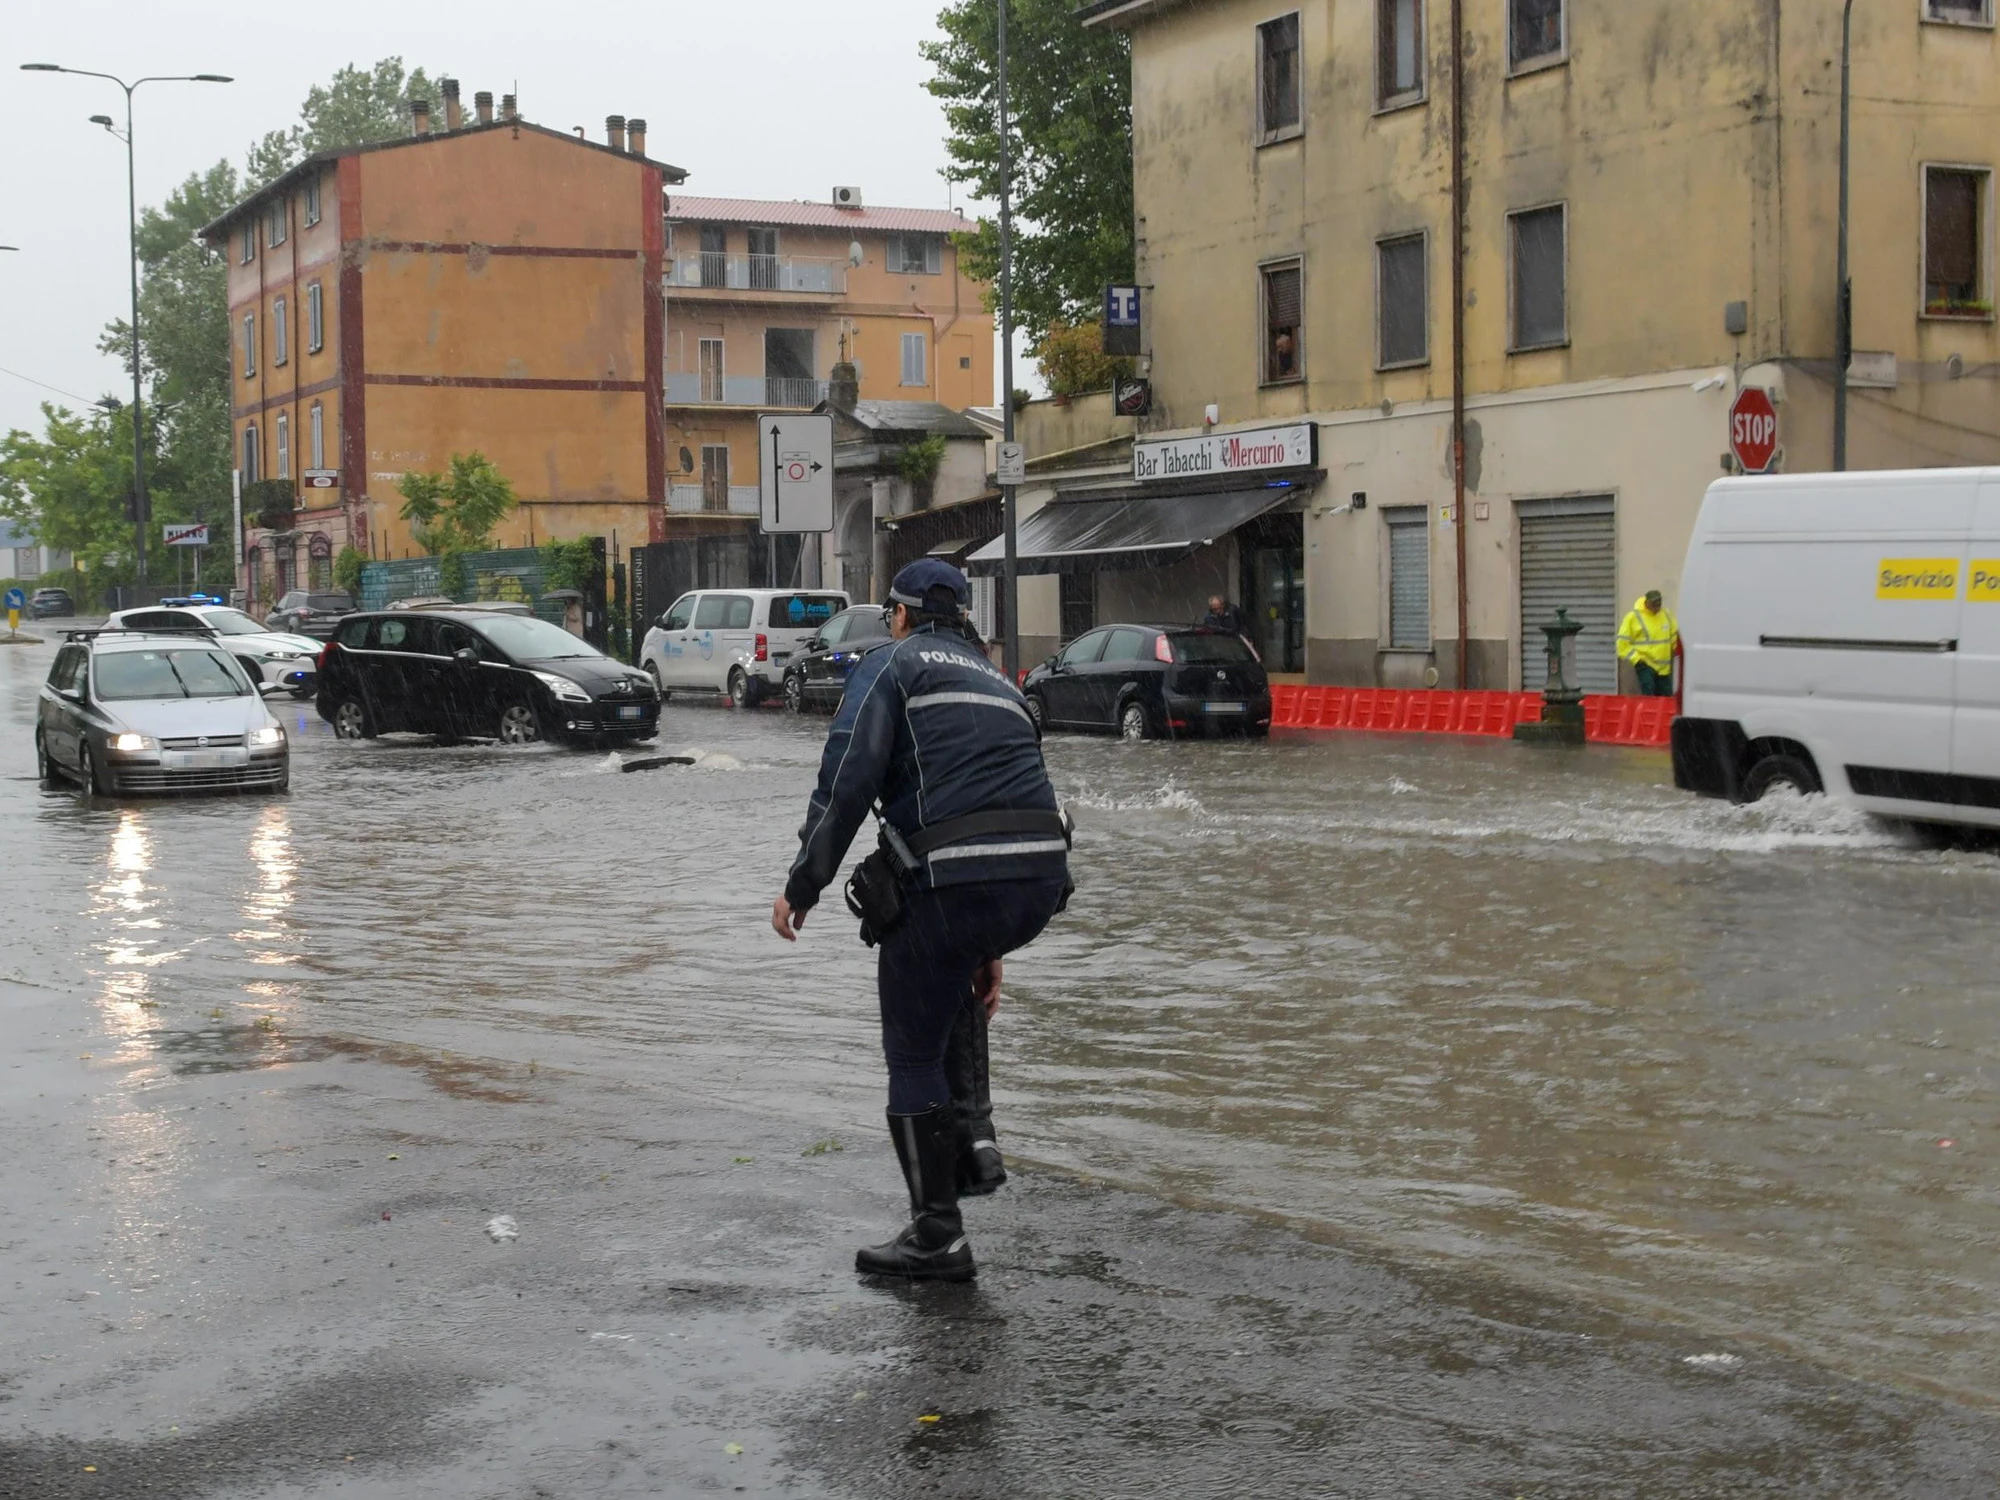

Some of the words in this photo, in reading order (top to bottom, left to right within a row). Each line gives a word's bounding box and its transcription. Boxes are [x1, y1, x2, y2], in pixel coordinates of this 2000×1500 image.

[1734, 413, 1775, 446] STOP
[1137, 451, 1158, 477] Bar
[1161, 441, 1212, 474] Tabacchi
[1229, 436, 1285, 468] Mercurio
[1880, 569, 1954, 588] Servizio
[1973, 571, 2000, 590] Po
[919, 651, 982, 672] POLIZIA
